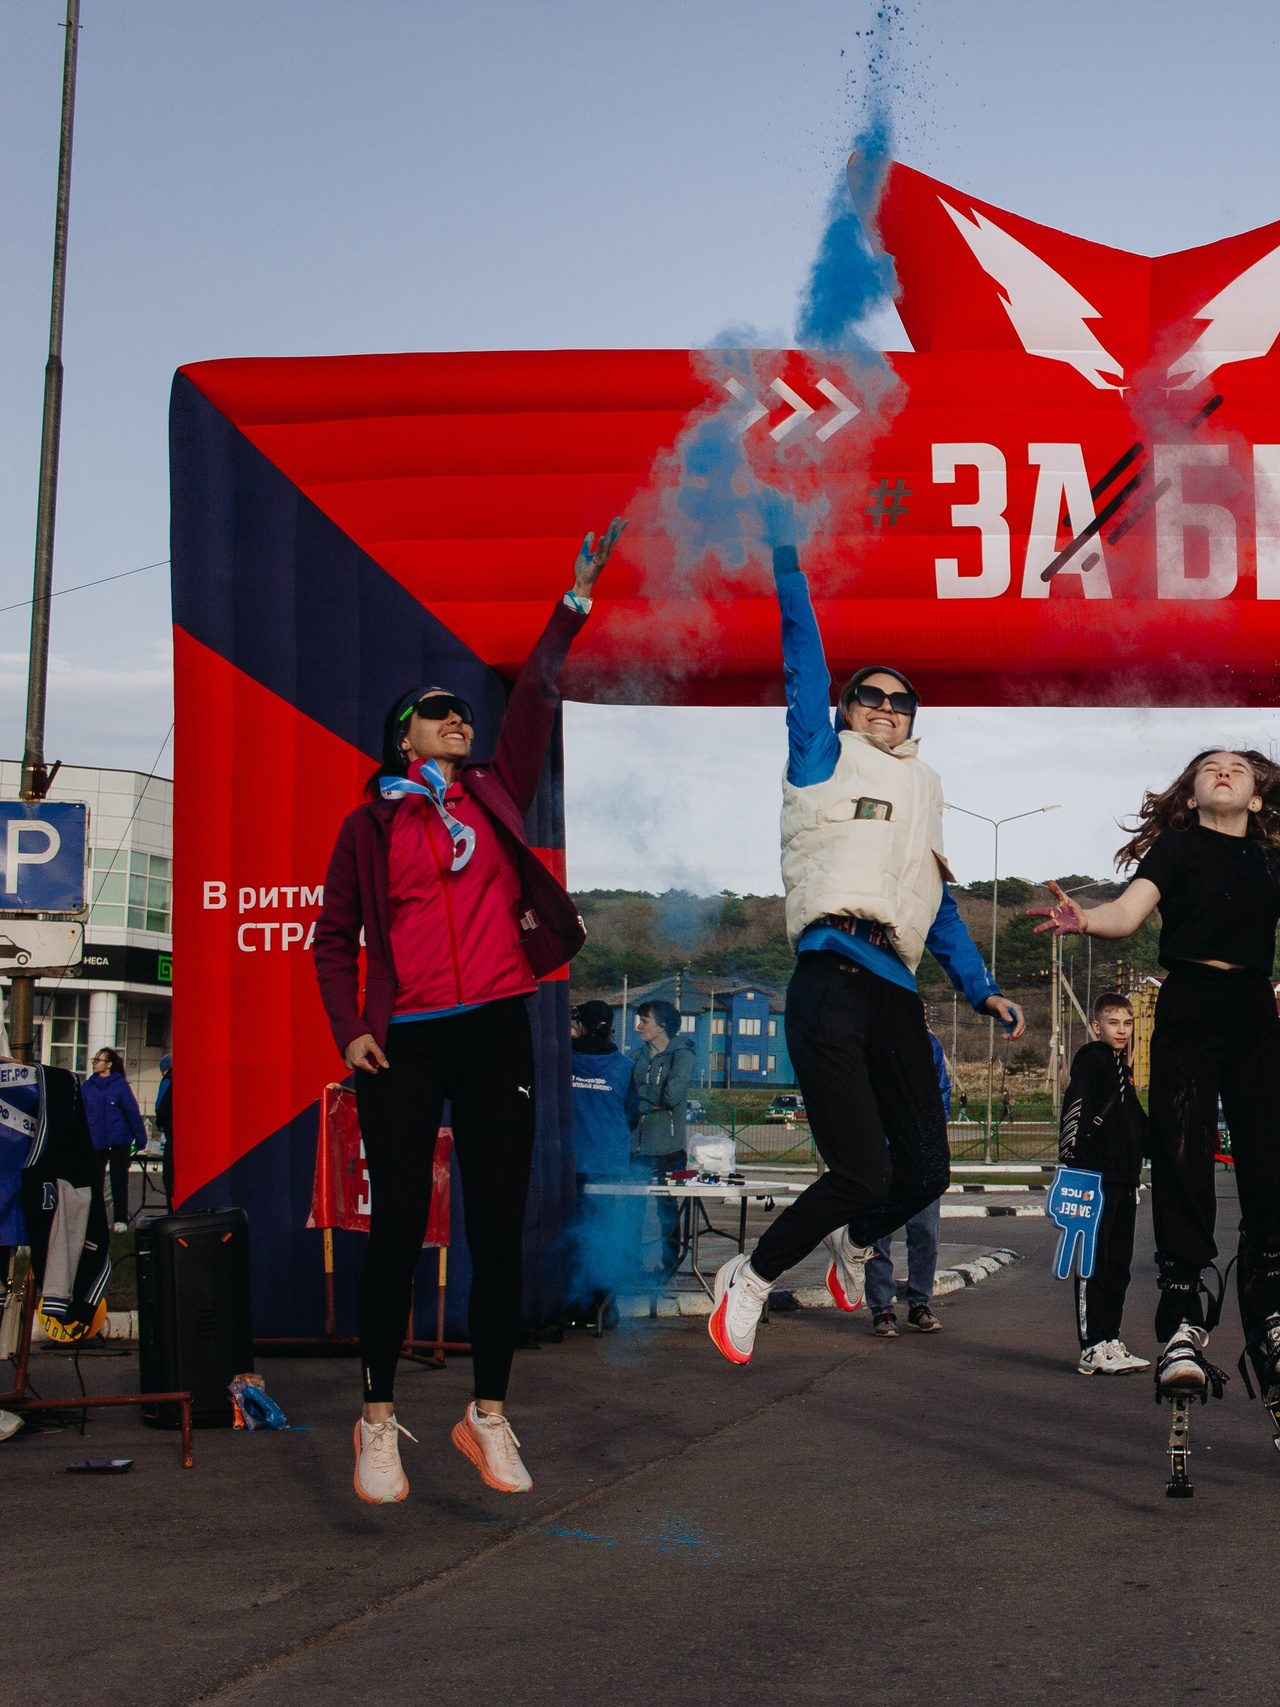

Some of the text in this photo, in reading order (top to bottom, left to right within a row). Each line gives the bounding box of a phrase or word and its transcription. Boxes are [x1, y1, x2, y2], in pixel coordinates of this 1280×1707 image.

[6, 820, 61, 894] P
[203, 881, 227, 910] В
[237, 921, 318, 953] СТР
